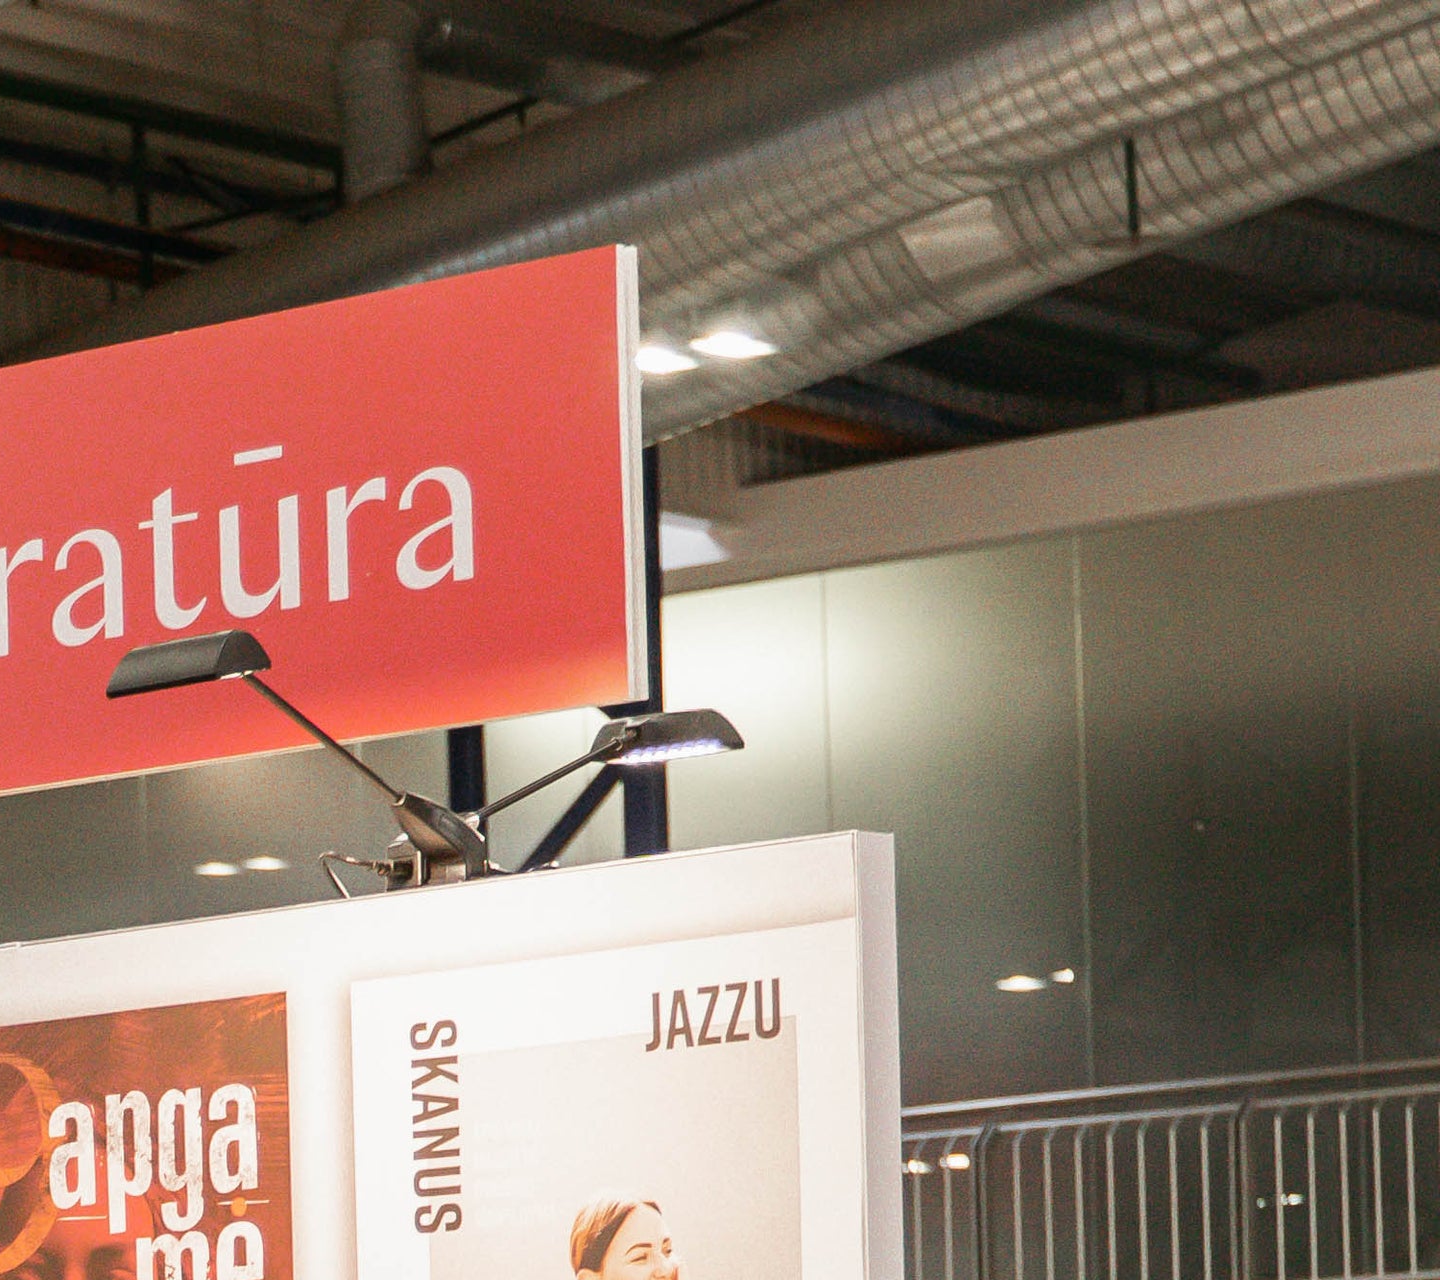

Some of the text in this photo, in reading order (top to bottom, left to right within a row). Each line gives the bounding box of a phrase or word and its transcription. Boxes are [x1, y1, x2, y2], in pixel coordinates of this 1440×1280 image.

[646, 976, 783, 1053] JAZZU
[48, 1080, 260, 1234] apga
[409, 1016, 463, 1235] SKANUS
